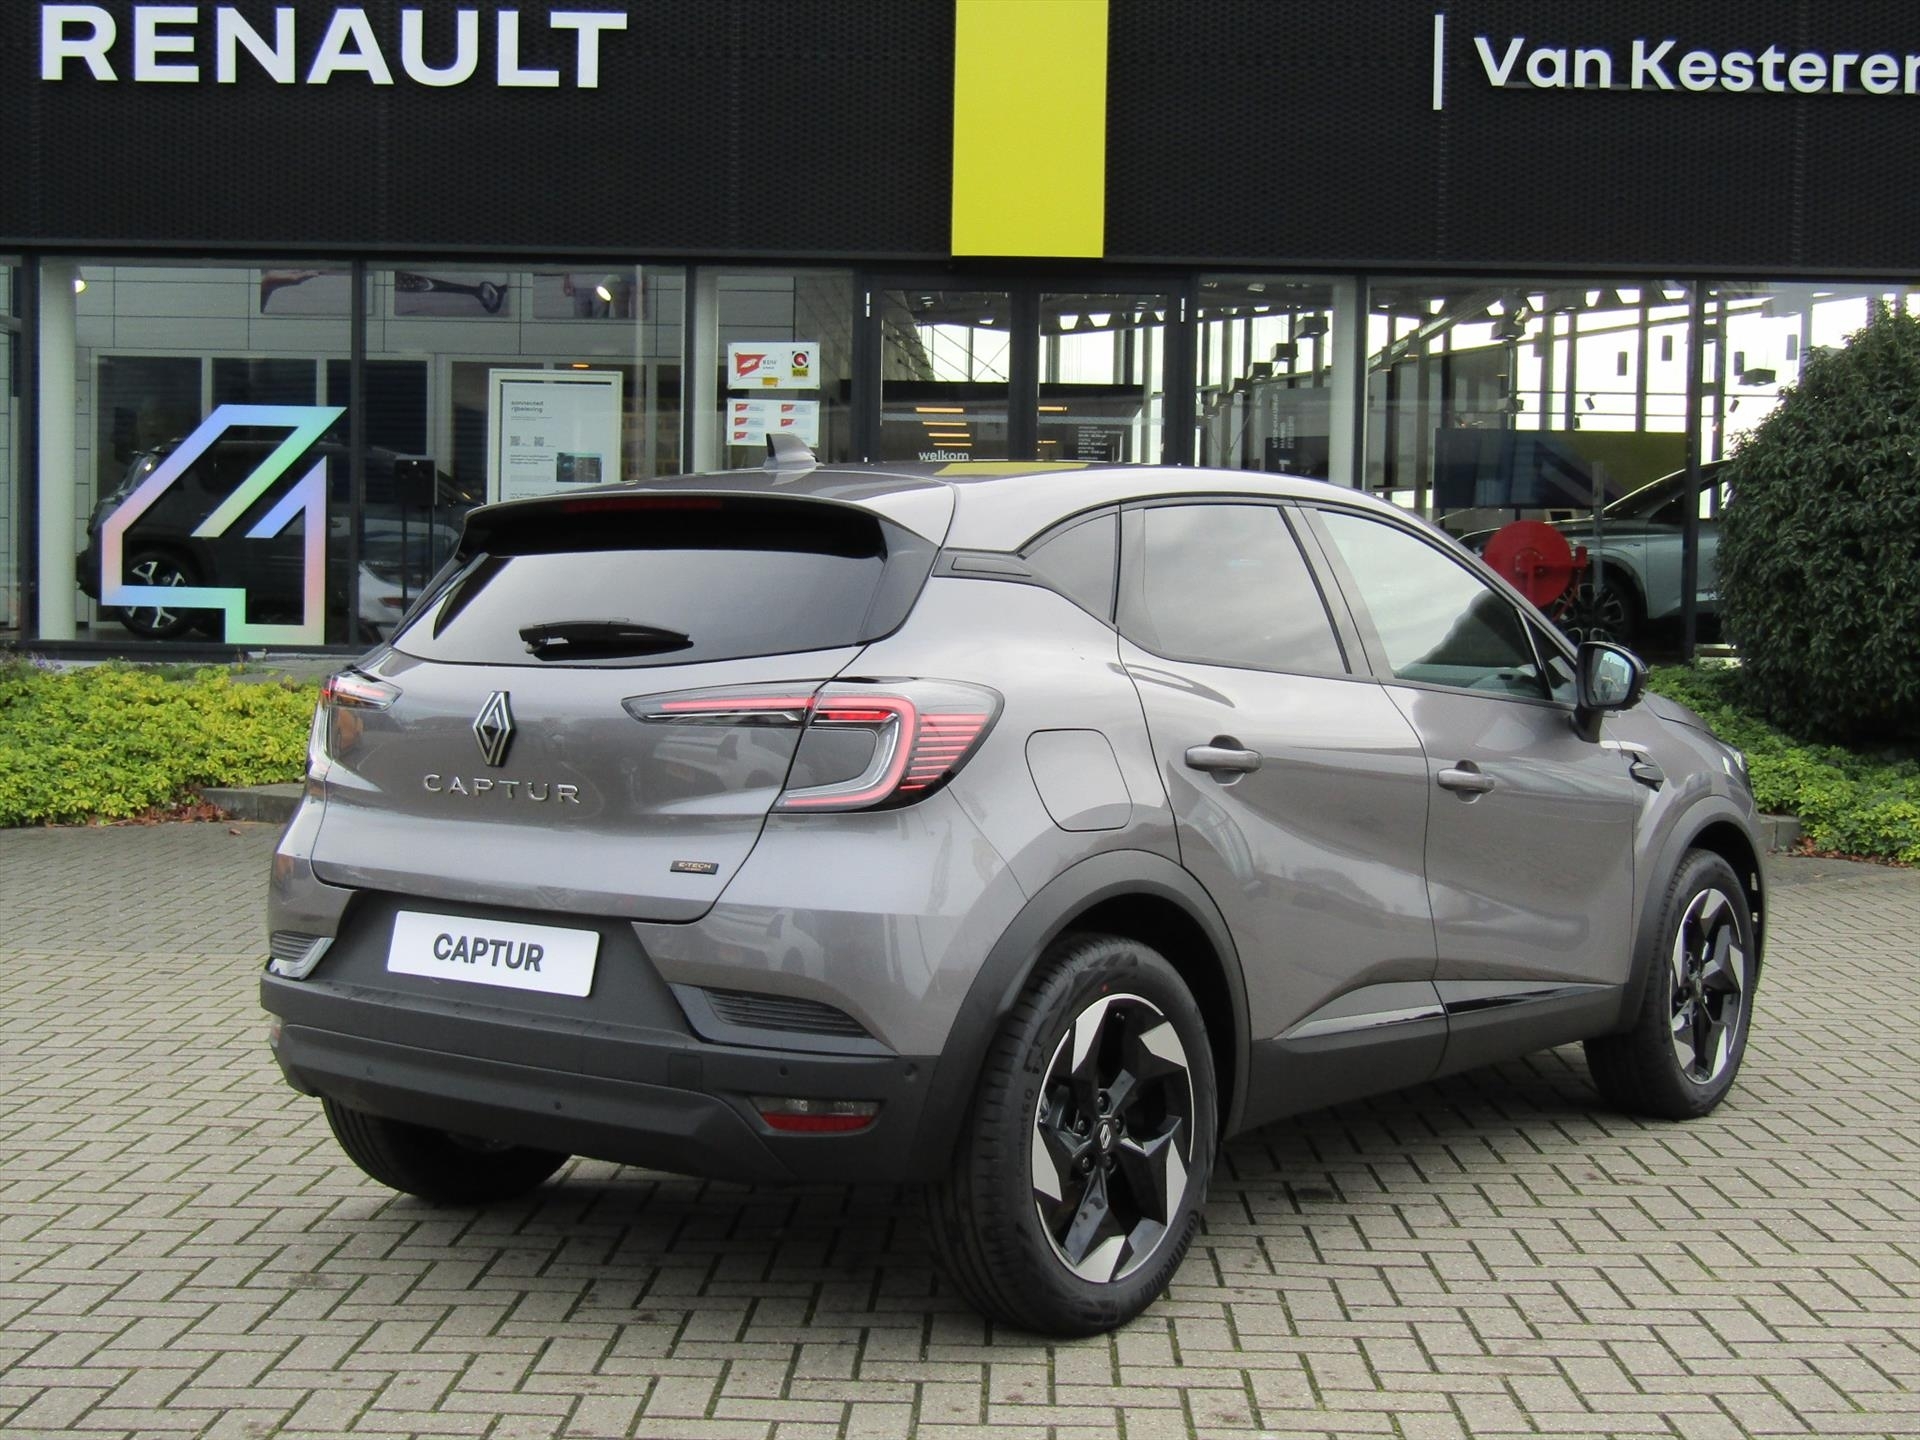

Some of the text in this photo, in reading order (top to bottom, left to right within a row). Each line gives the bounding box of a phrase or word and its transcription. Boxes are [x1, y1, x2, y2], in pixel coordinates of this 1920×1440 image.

[41, 4, 628, 89] RENAULT
[1474, 36, 1612, 89] Van
[918, 449, 969, 461] welkom
[422, 773, 582, 804] CAPTUR
[433, 931, 545, 973] CAPTUR
